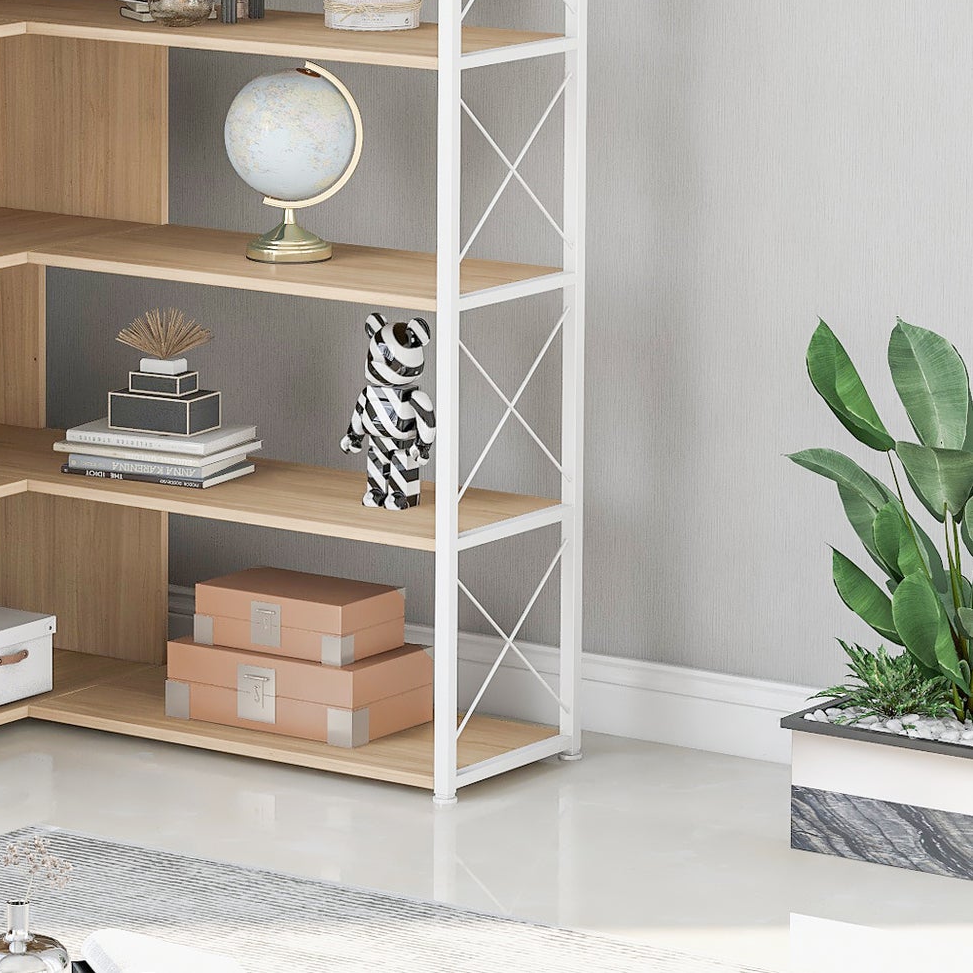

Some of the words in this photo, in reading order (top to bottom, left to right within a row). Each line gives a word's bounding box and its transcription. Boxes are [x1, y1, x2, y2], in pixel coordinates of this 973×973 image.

[111, 462, 163, 475] KARENINA
[165, 467, 196, 477] ANNA
[85, 470, 105, 478] IDIOT
